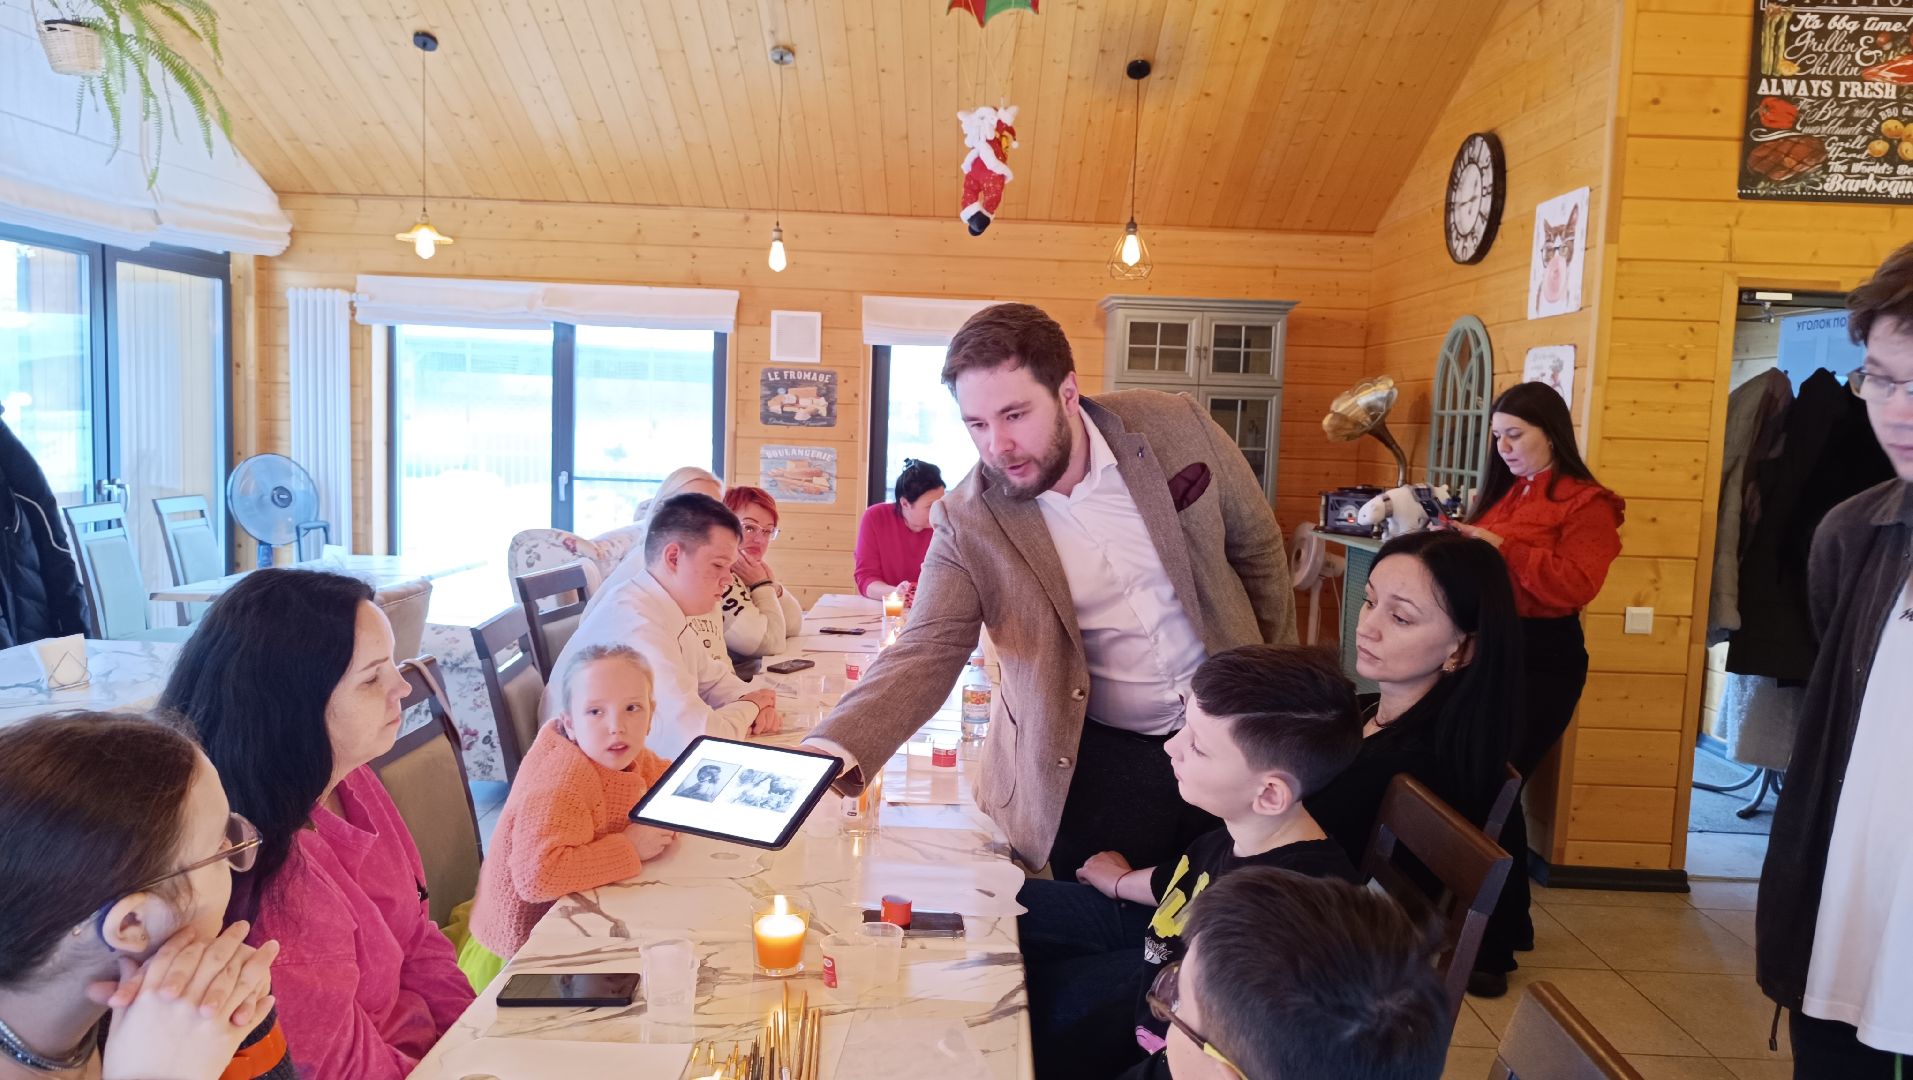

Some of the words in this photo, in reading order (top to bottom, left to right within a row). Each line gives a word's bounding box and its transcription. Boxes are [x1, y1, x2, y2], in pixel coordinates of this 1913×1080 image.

[1827, 14, 1860, 34] bbq
[1863, 16, 1913, 33] time!
[1784, 30, 1858, 60] Grillin
[1855, 35, 1883, 67] &
[1795, 53, 1861, 76] Chillin
[1757, 78, 1833, 97] ALWAYS
[1838, 81, 1898, 99] FRESH
[767, 371, 780, 381] LE
[783, 370, 832, 383] FROMAGE
